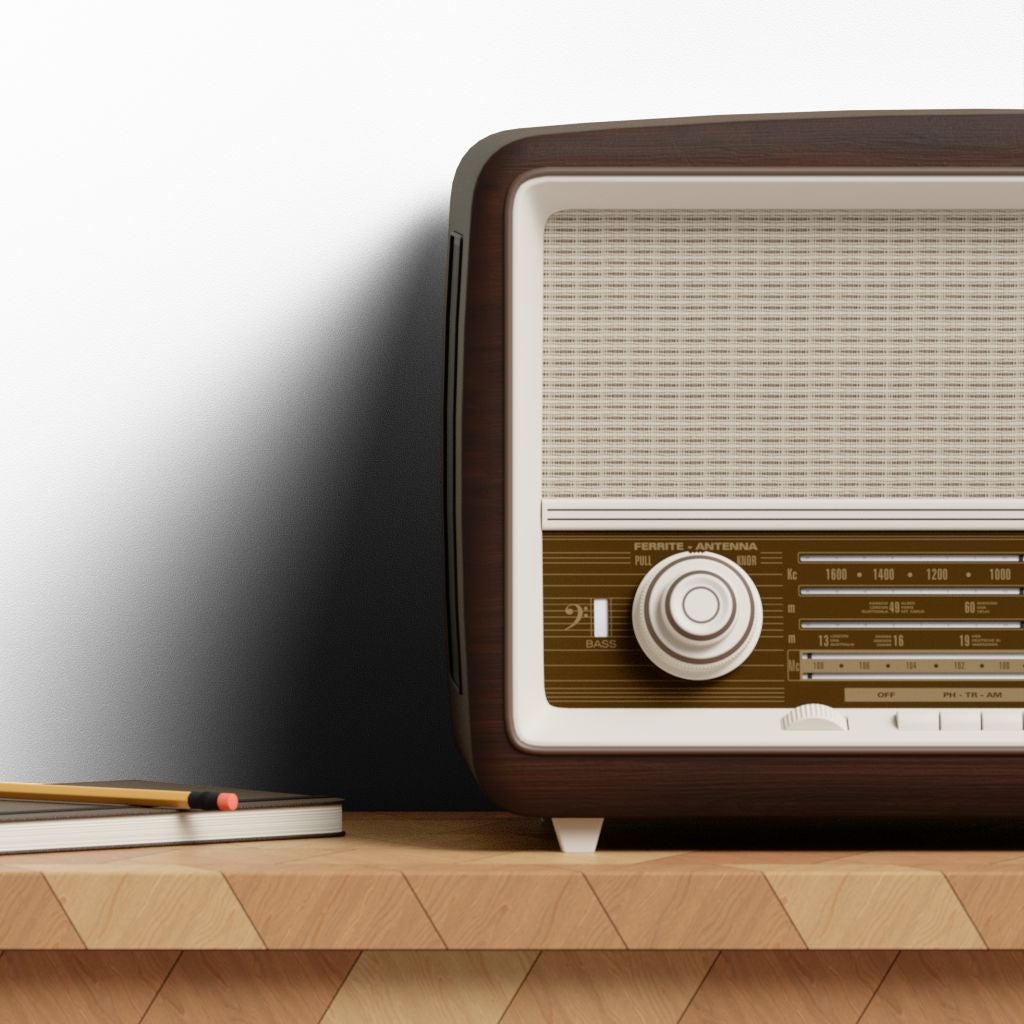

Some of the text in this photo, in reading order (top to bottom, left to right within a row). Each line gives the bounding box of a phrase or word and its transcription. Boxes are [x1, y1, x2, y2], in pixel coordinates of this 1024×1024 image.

[634, 542, 684, 550] FERRITE
[696, 542, 758, 550] ANTENNA
[635, 555, 652, 567] PULL
[787, 568, 1011, 580] Kc 1600 1400 1200 1000
[889, 601, 900, 613] 49
[965, 601, 975, 613] 60
[586, 640, 616, 648] BASS
[819, 635, 829, 647] 13
[894, 635, 904, 646] 16
[960, 635, 970, 646] 19
[877, 691, 896, 699] OFF
